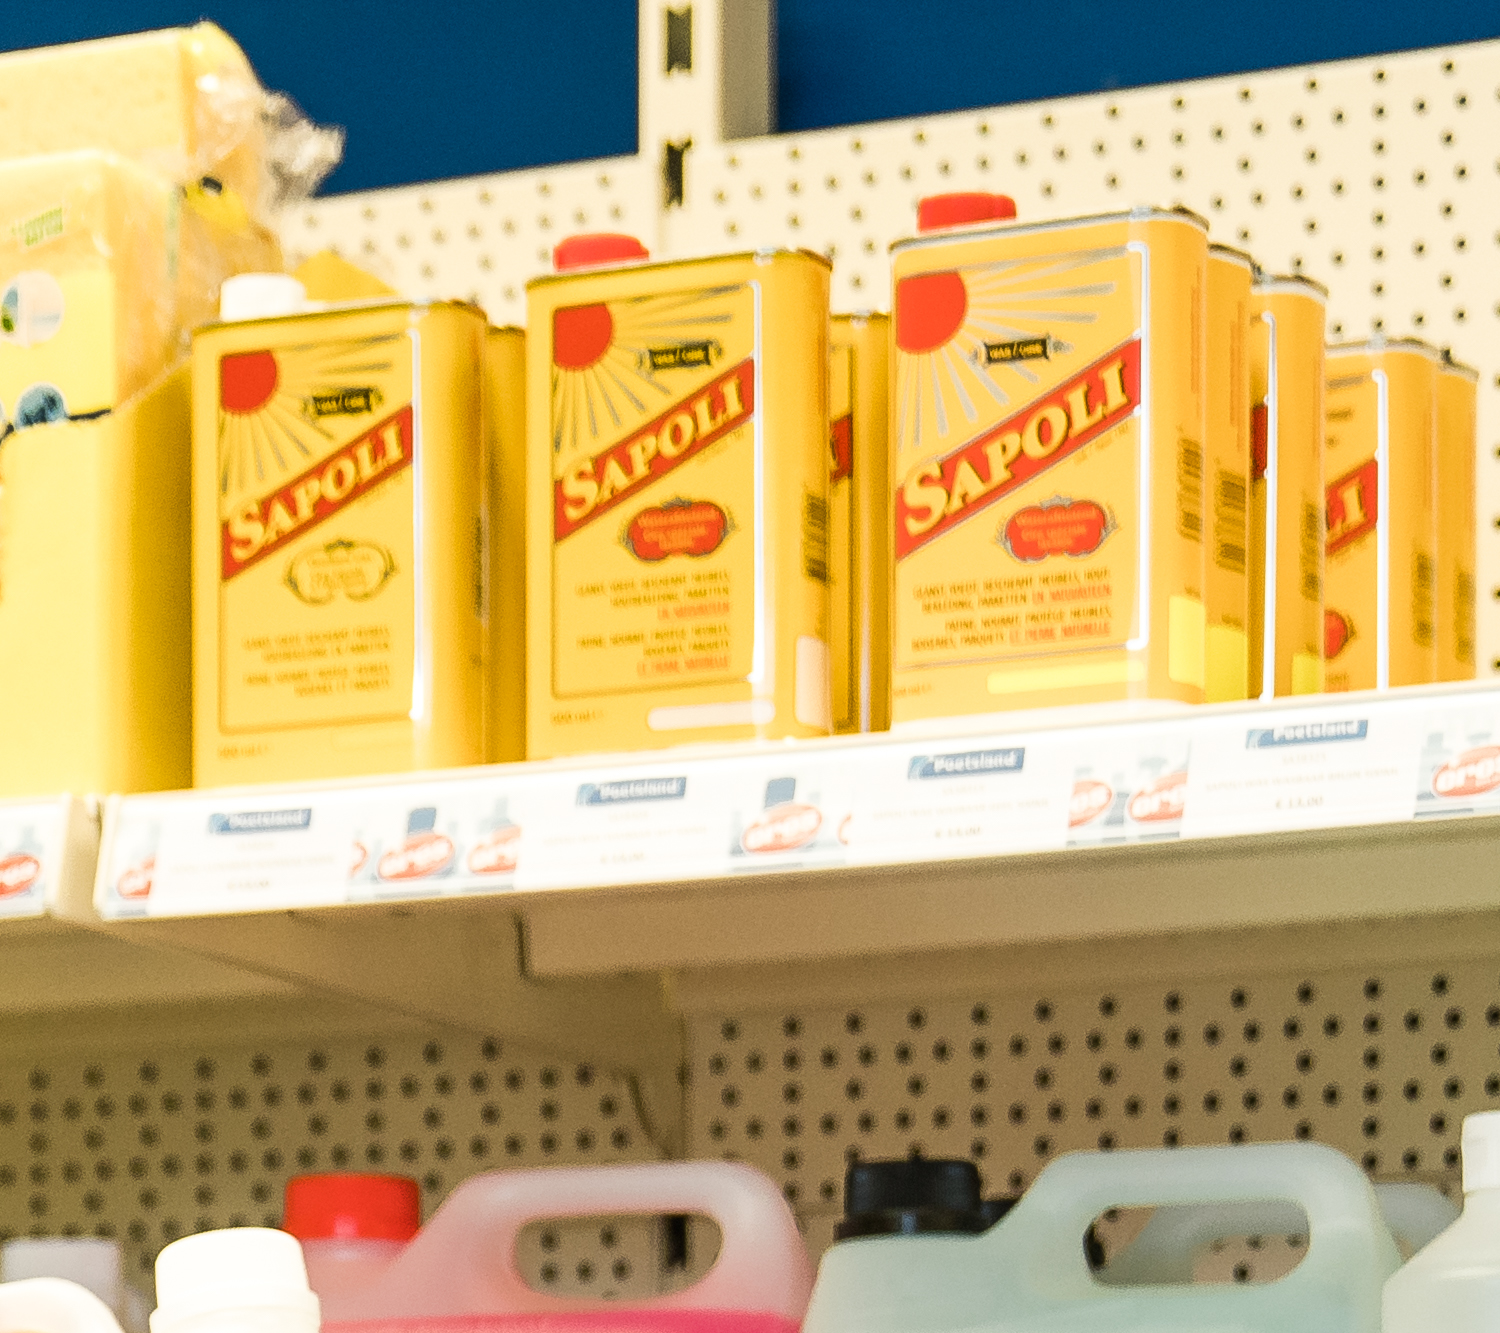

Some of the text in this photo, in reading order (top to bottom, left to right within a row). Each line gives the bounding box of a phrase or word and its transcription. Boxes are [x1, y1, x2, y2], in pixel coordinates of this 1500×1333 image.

[228, 422, 404, 563] SAPOLI
[562, 374, 745, 521] SAPOLI
[904, 359, 1130, 537] SAPOLI
[933, 749, 1016, 775] Poetsland
[1272, 720, 1359, 744] Poetsland
